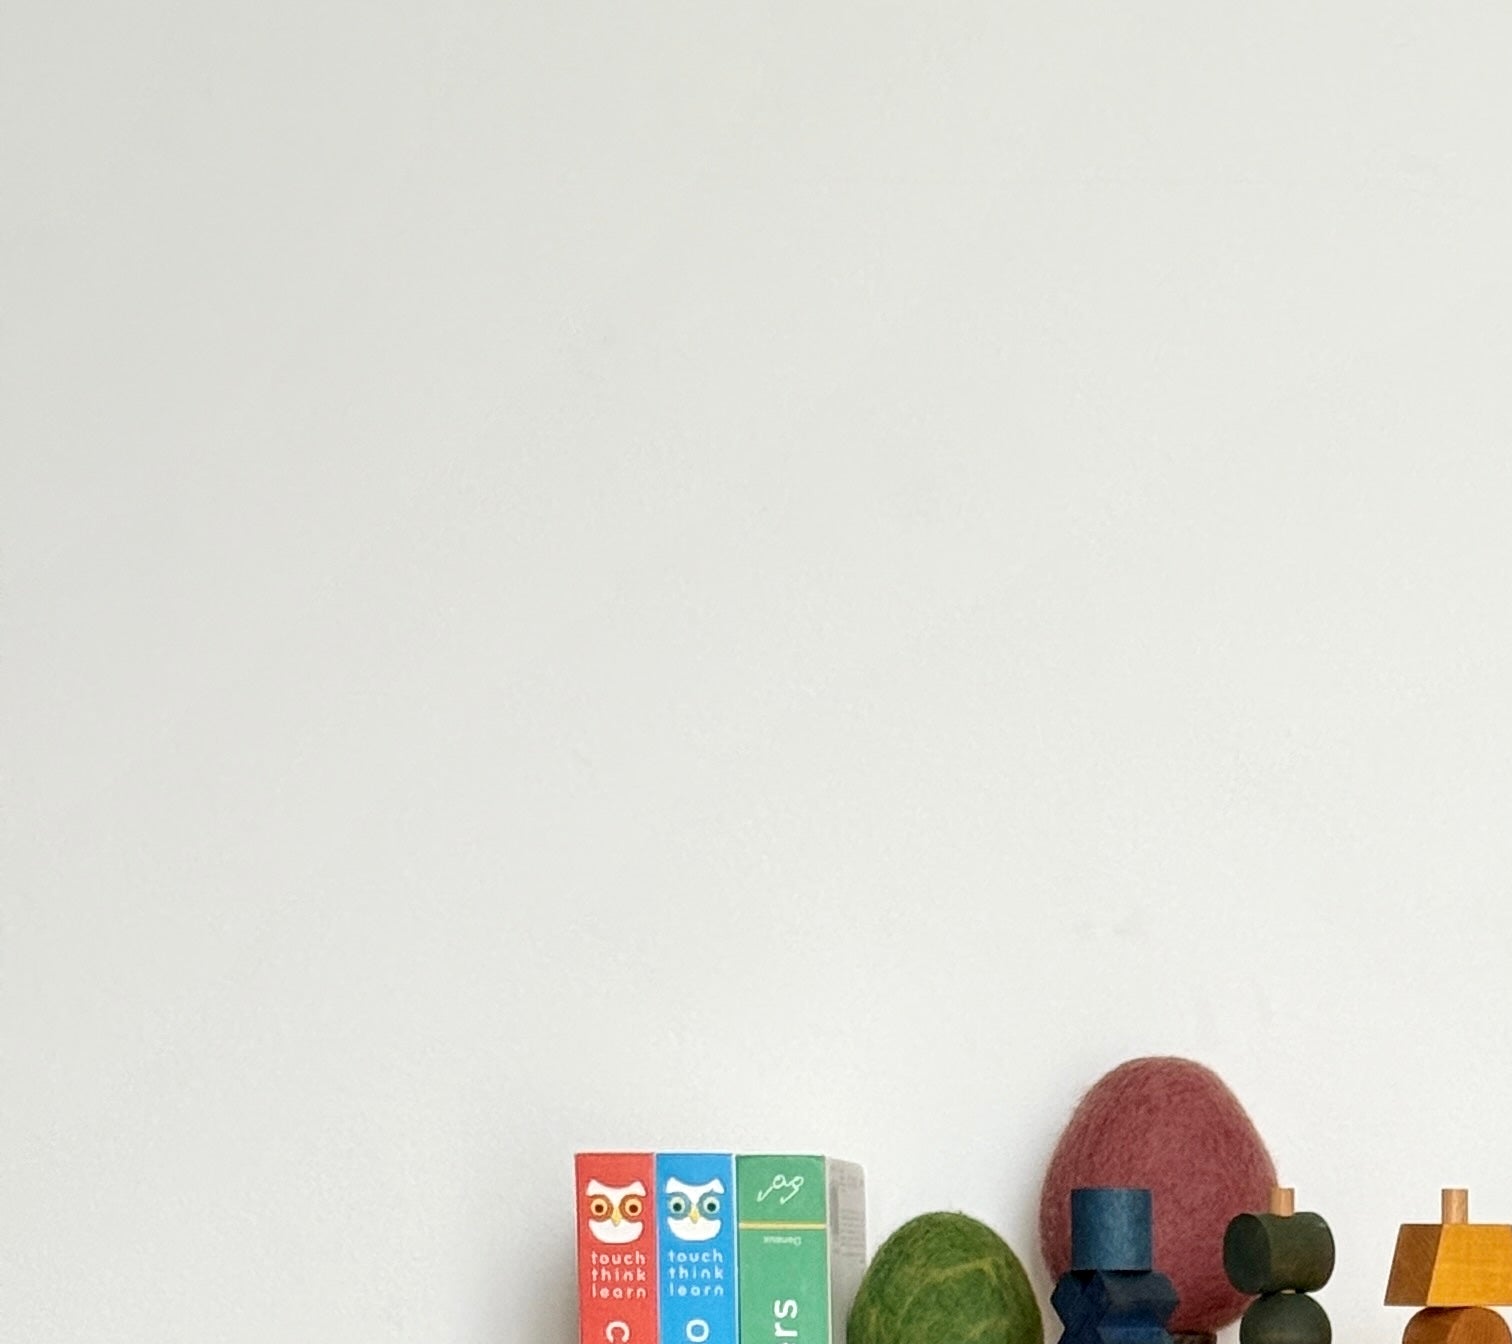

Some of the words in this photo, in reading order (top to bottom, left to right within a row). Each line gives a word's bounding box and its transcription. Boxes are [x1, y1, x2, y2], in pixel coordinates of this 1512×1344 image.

[591, 1250, 646, 1265] touch
[667, 1249, 723, 1263] touch
[591, 1268, 647, 1282] think
[669, 1265, 724, 1279] think
[592, 1283, 647, 1298] learn
[669, 1281, 724, 1297] learn
